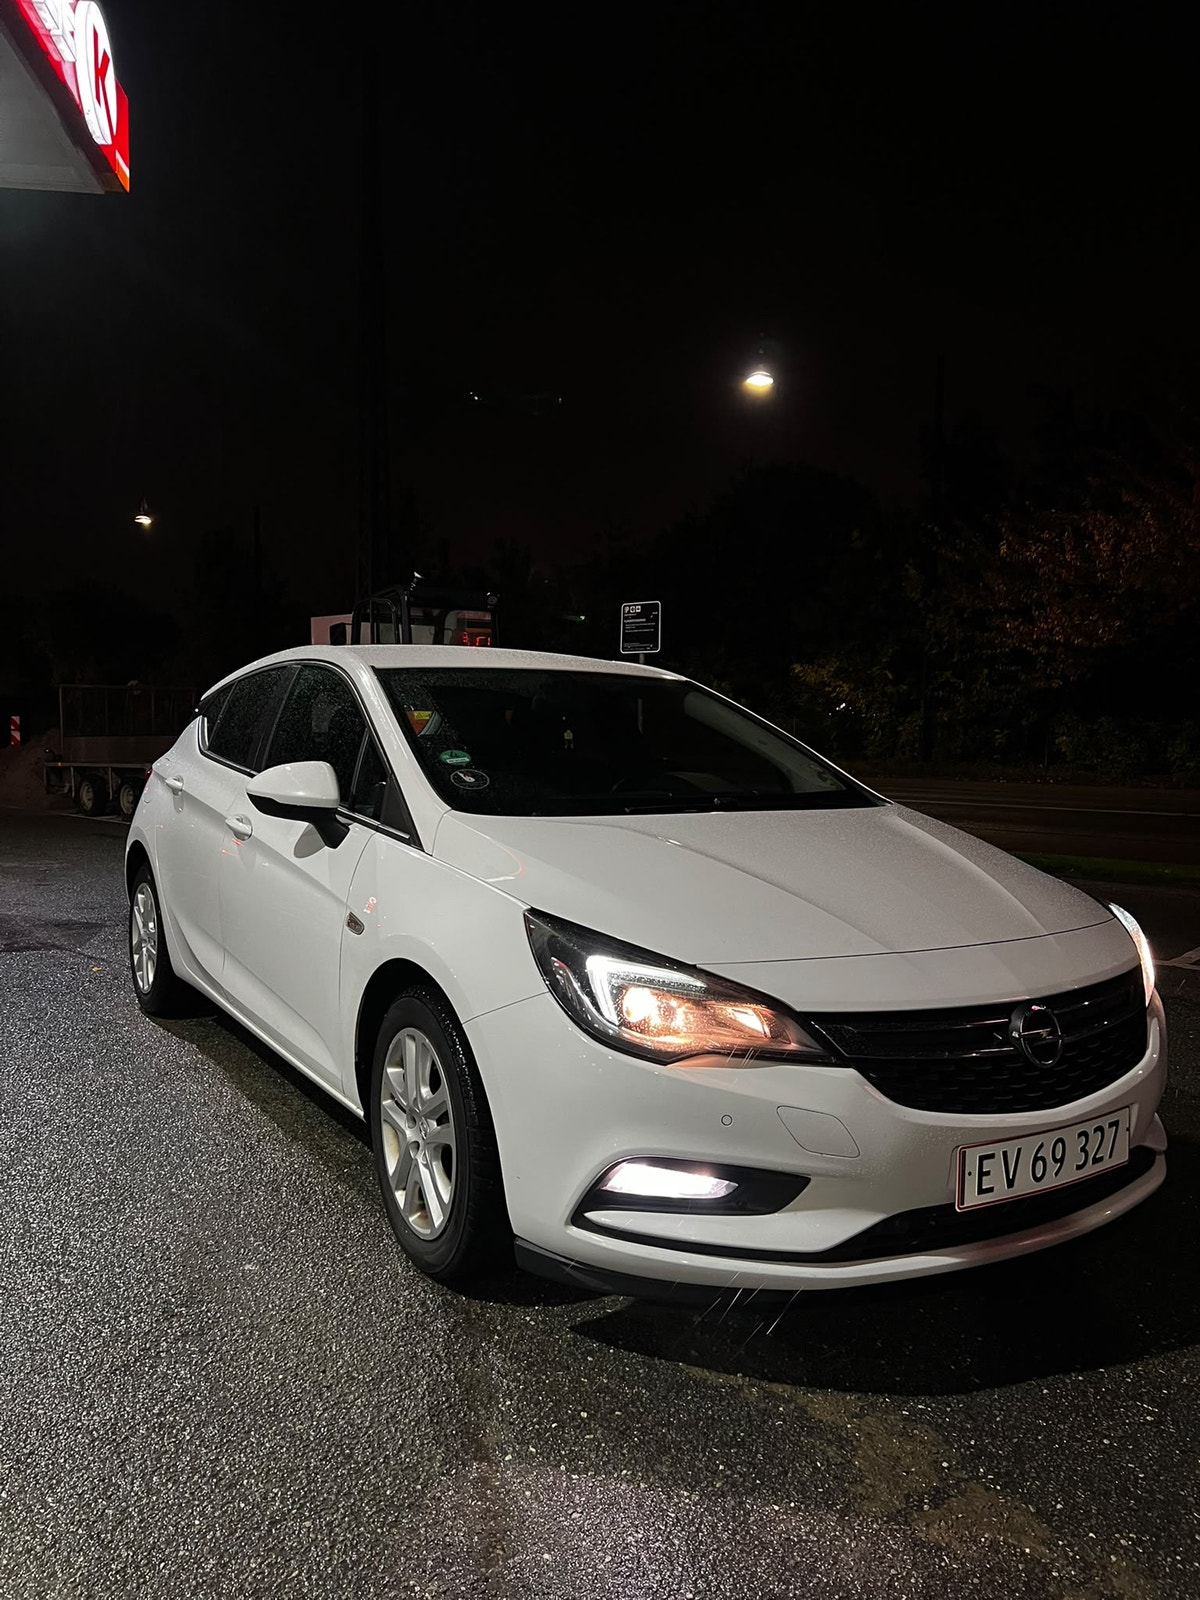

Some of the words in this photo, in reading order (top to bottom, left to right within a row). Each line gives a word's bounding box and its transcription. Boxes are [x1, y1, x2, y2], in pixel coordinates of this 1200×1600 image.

[976, 1147, 1022, 1196] EV
[1030, 1137, 1067, 1183] 69
[1074, 1119, 1120, 1171] 327
